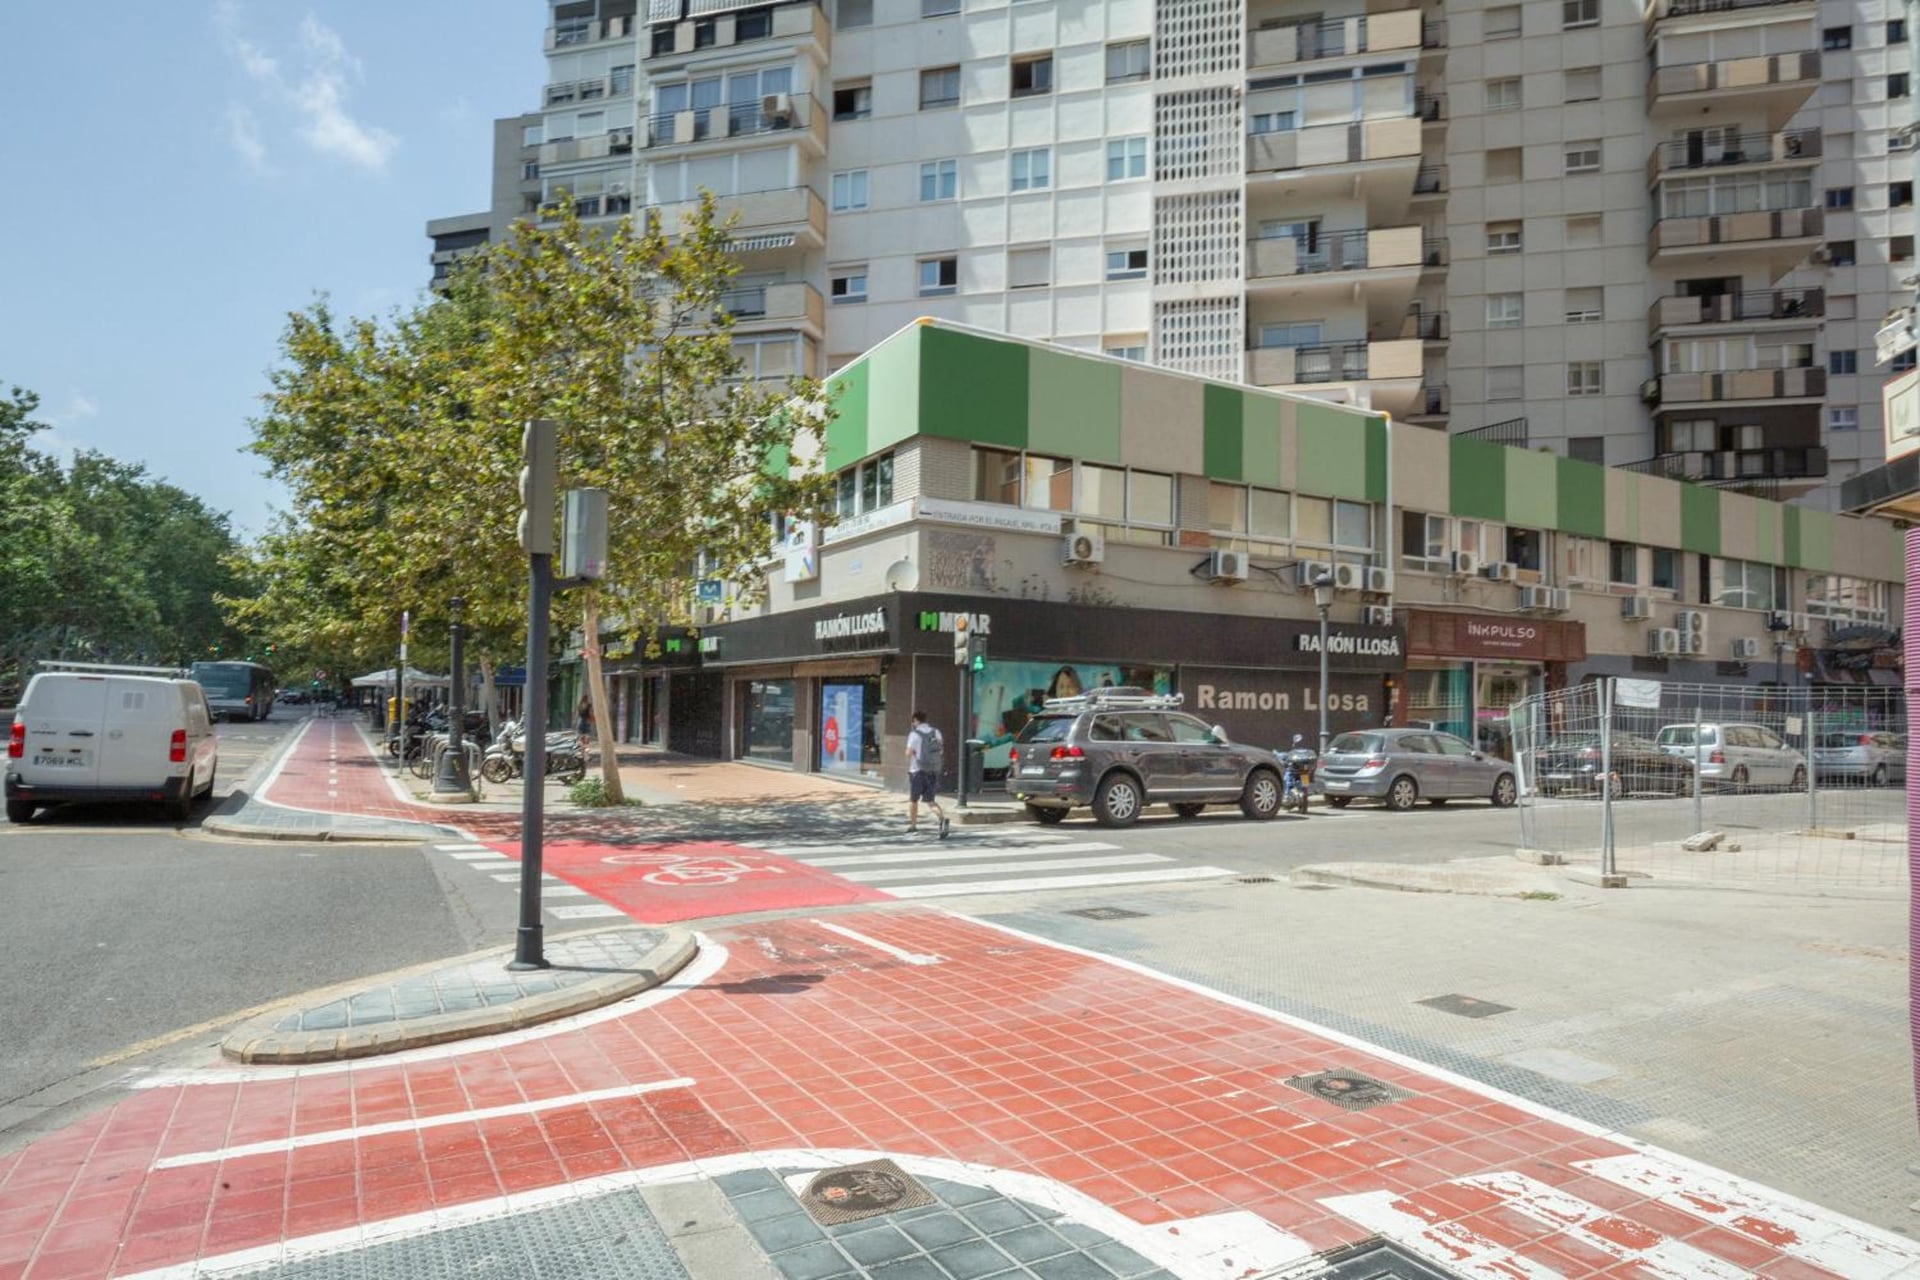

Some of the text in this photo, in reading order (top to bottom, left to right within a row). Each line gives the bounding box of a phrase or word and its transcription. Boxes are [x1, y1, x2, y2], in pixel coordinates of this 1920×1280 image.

[815, 607, 885, 640] RAMÓN LLOSÁ
[1356, 635, 1399, 656] LLOSÁ
[1197, 684, 1289, 710] Ramon
